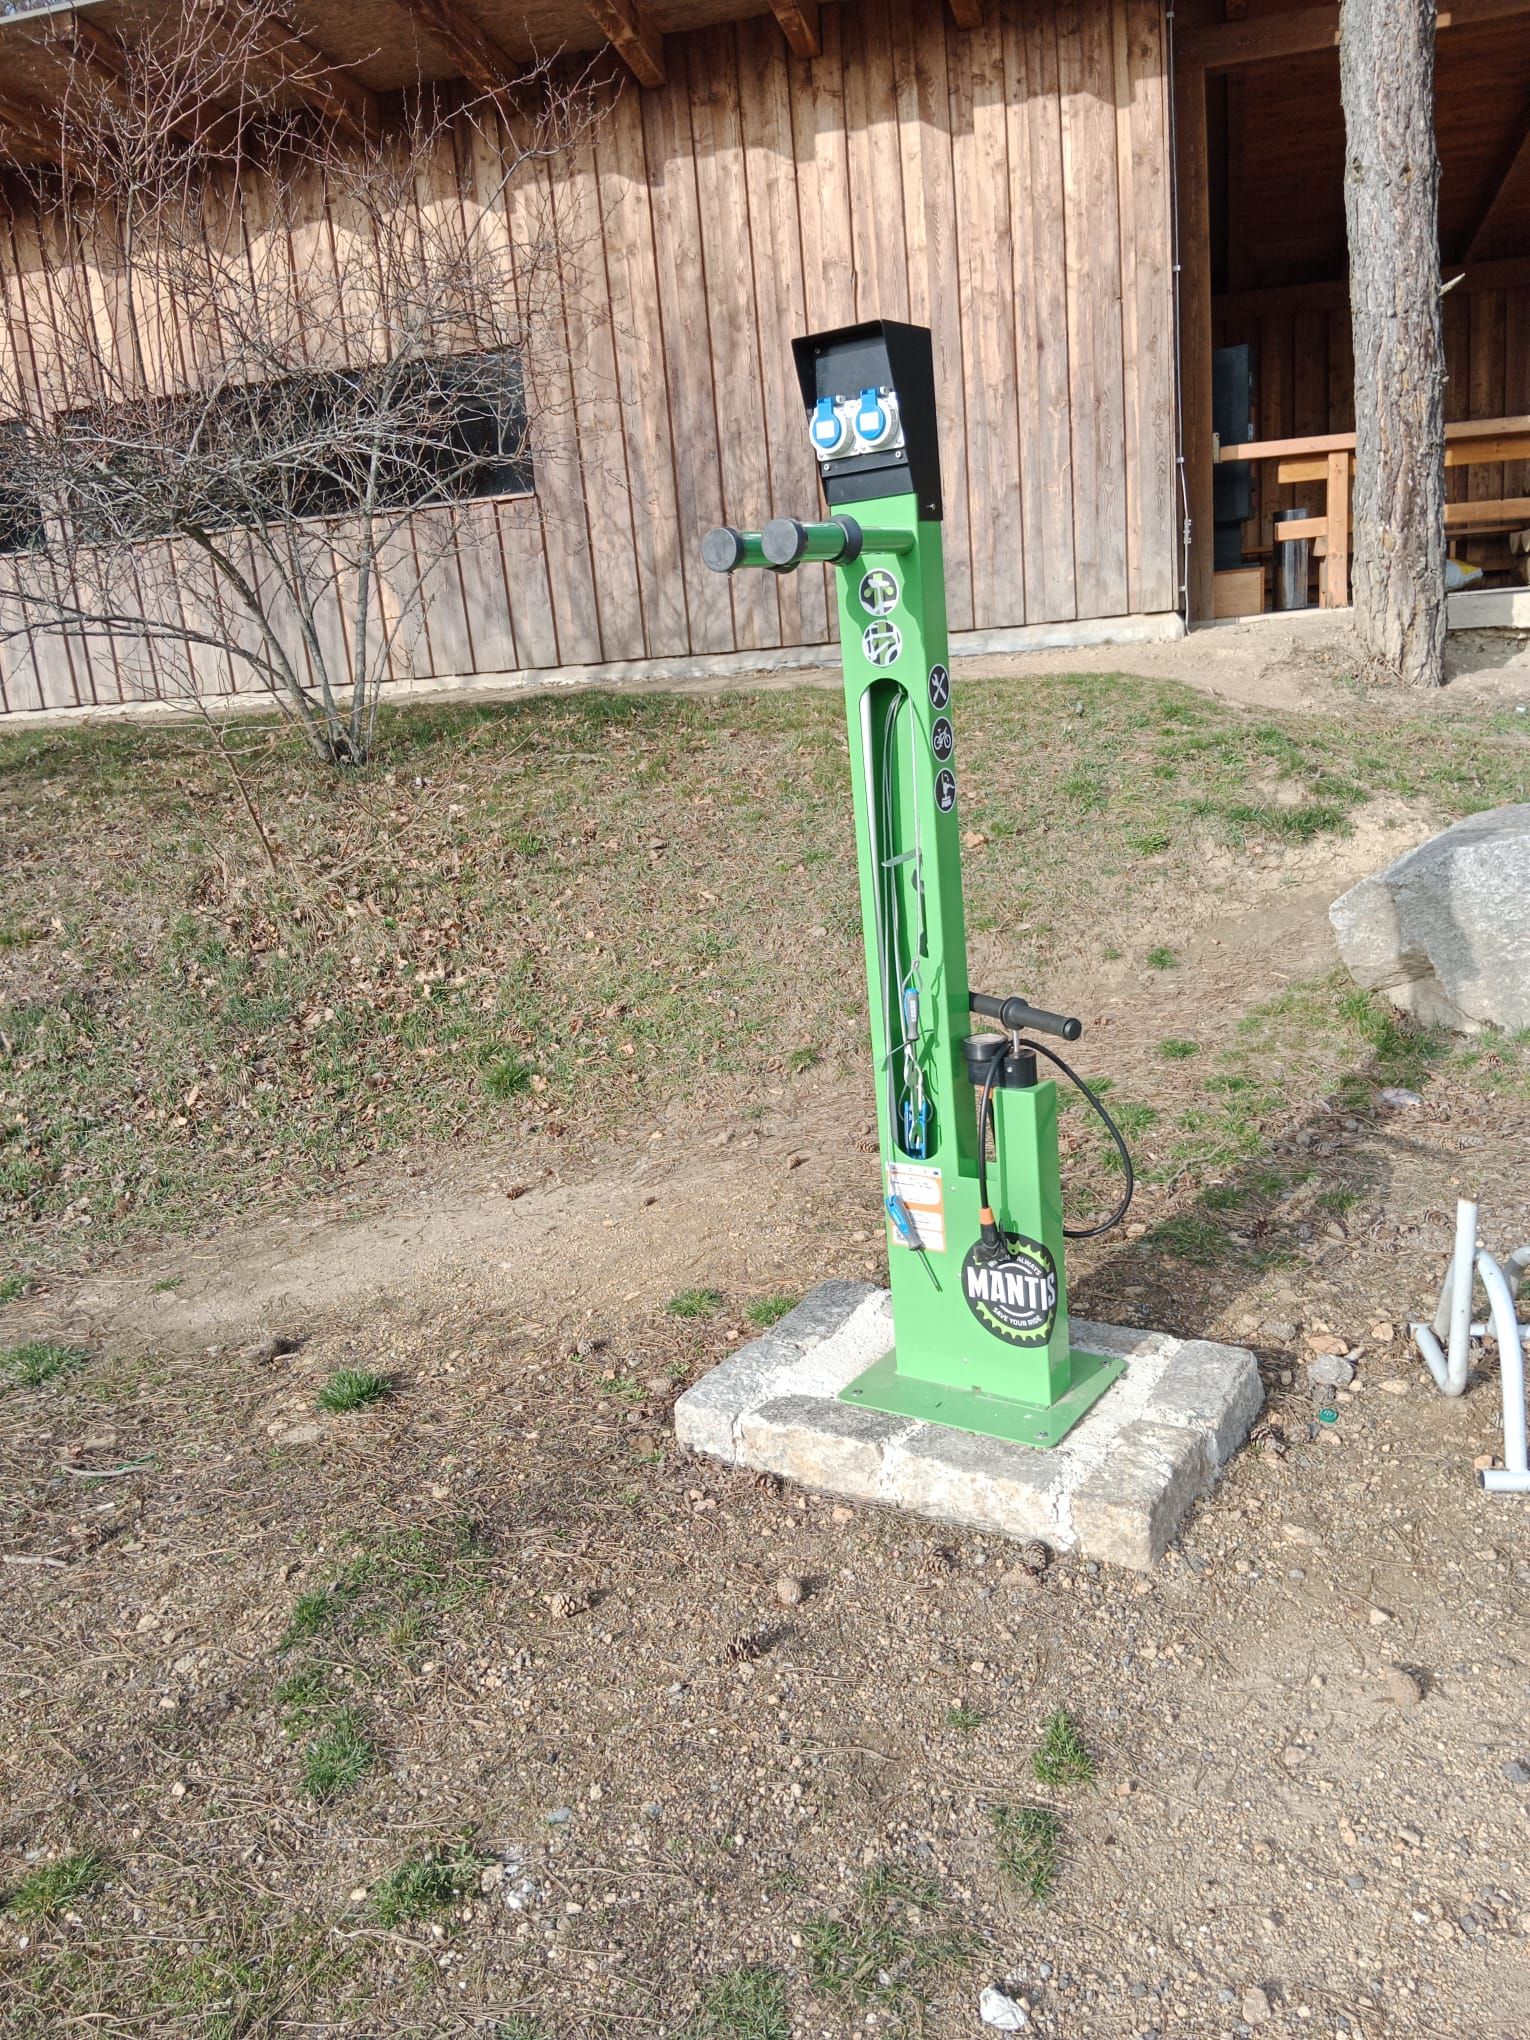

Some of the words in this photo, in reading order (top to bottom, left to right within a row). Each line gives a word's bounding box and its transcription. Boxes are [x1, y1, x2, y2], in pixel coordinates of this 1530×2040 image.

[1016, 1256, 1042, 1275] ALWAYS
[967, 1266, 1056, 1311] MANTIS
[992, 1307, 1008, 1322] SAVE
[1009, 1318, 1027, 1327] YOUR
[1027, 1314, 1042, 1326] RIDE
